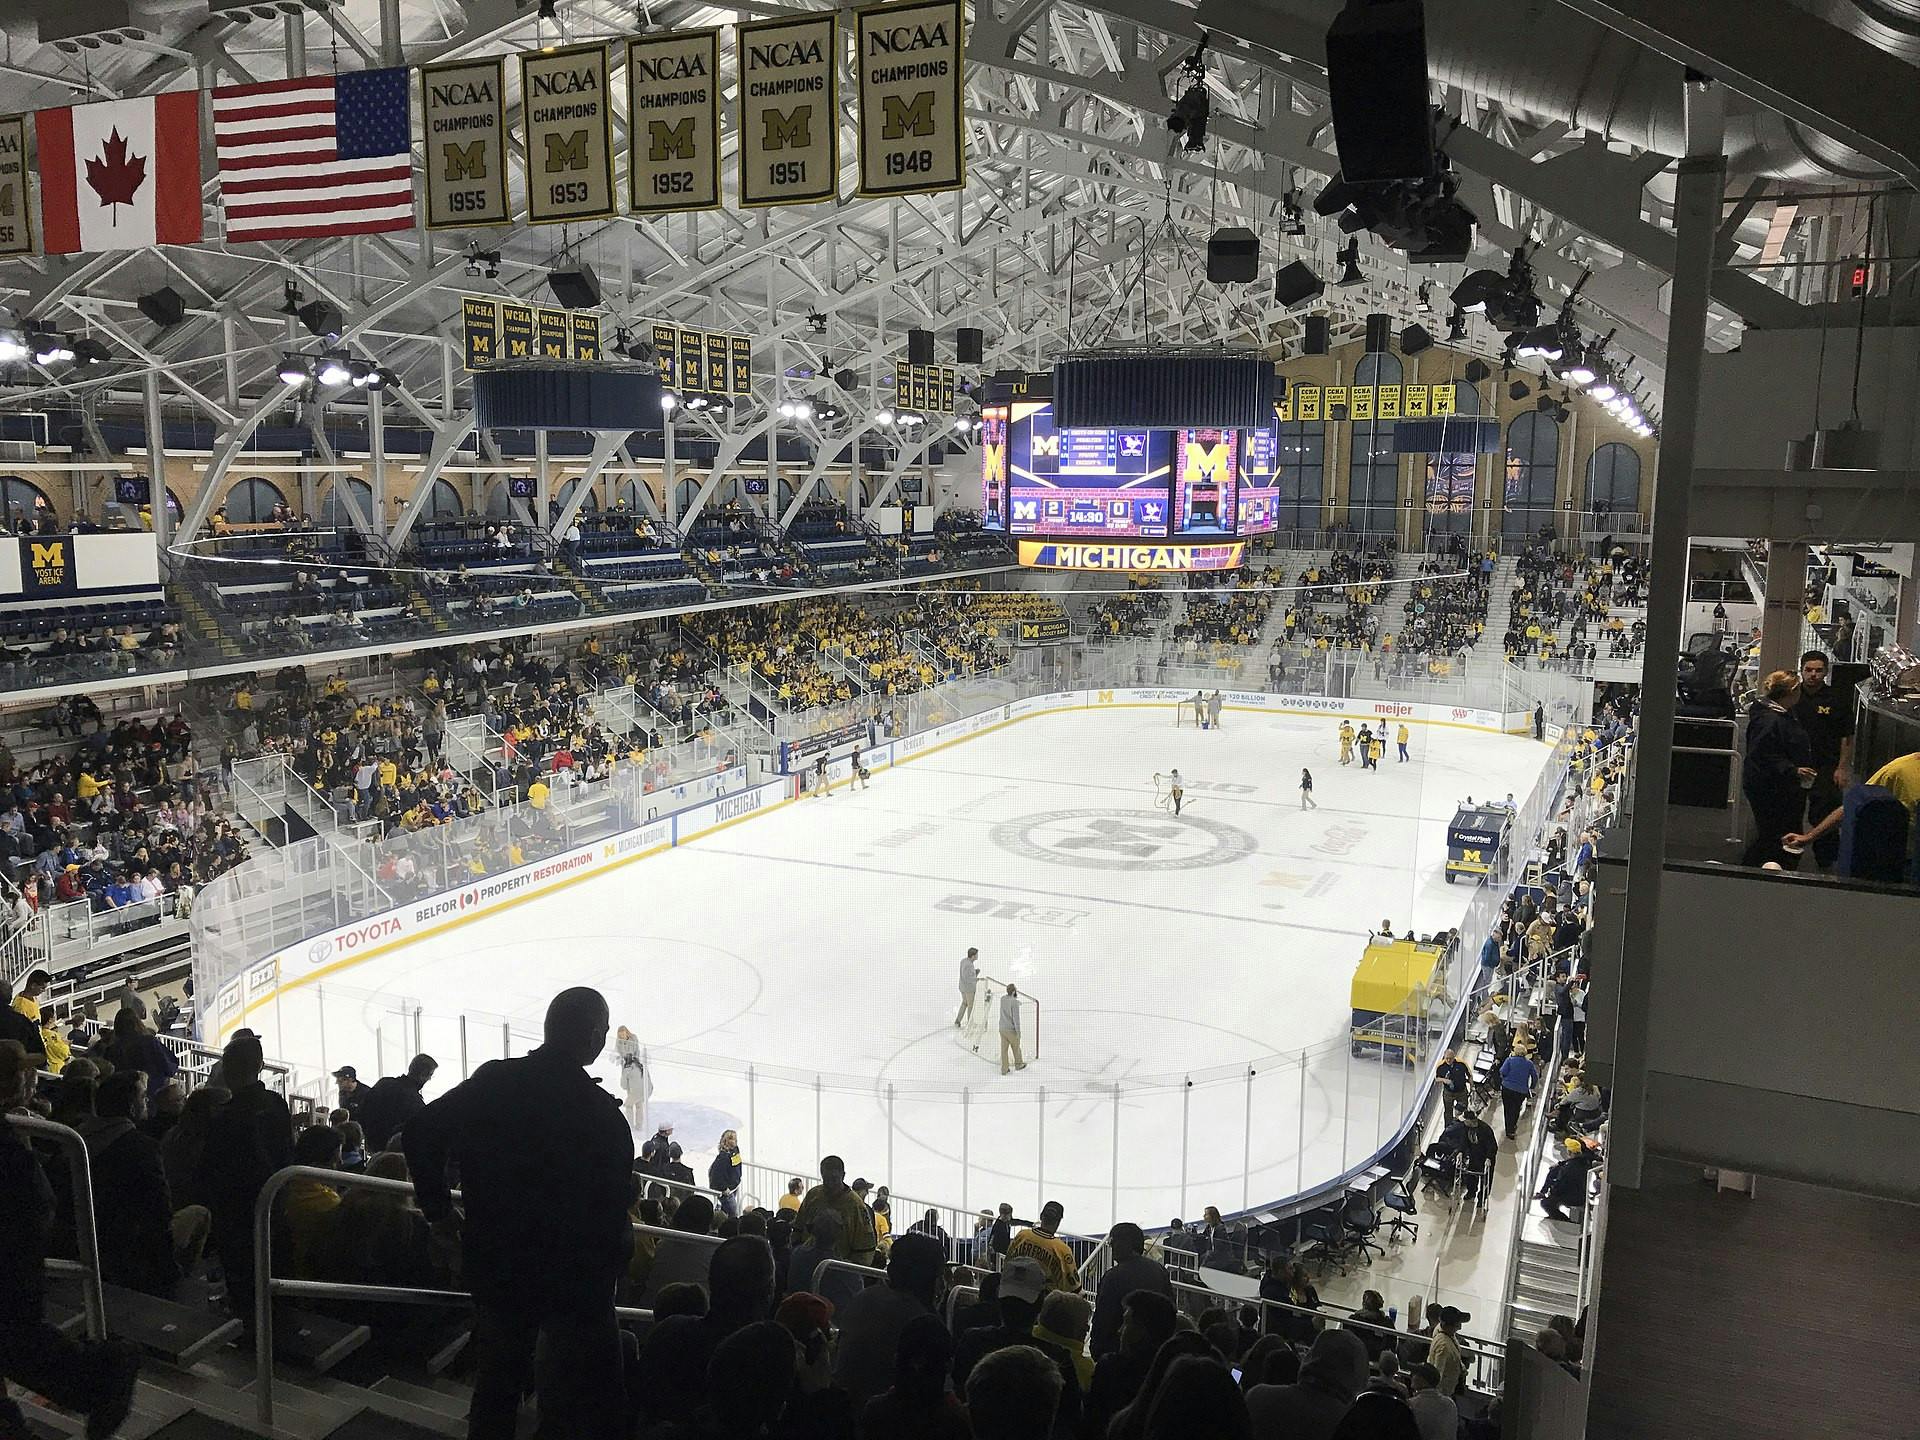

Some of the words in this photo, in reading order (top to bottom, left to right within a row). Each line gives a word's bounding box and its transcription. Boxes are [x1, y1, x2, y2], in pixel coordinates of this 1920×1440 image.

[868, 22, 949, 56] NCAA
[749, 39, 824, 70] NCAA
[637, 53, 707, 83] NCAA
[871, 60, 948, 84] CHAMPIONS
[532, 68, 597, 97] NCAA
[751, 76, 823, 97] CHAMPIONS
[431, 81, 493, 108] NCAA
[640, 89, 706, 109] CHAMPIONS
[534, 103, 597, 123] CHAMPIONS
[882, 91, 935, 140] M
[433, 114, 493, 132] CHAMPIONS
[762, 105, 812, 150] M
[0, 135, 18, 153] AA
[649, 117, 695, 161] M
[545, 130, 588, 173] M
[443, 140, 486, 181] M
[885, 150, 932, 175] 1948
[769, 161, 806, 185] 1951
[652, 172, 694, 194] 1952
[449, 190, 486, 212] 1955
[550, 182, 588, 205] 1953
[0, 226, 14, 242] 56
[466, 304, 493, 317] WCHA
[504, 309, 531, 323] WCHA
[540, 314, 565, 327] WCHA
[575, 318, 596, 331] CCHA
[472, 335, 489, 352] M
[655, 329, 673, 341] CCHA
[683, 334, 700, 345] CCHA
[709, 338, 725, 349] CCHA
[511, 340, 527, 356] M
[546, 343, 561, 359] M
[580, 346, 594, 361] M
[733, 341, 749, 350] CCHA
[659, 356, 672, 371] M
[686, 360, 697, 374] M
[712, 363, 723, 377] M
[737, 365, 747, 379] M
[1304, 404, 1314, 412] M
[1356, 403, 1368, 411] M
[1383, 402, 1395, 410] M
[1410, 402, 1422, 410] M
[1437, 402, 1448, 410] M
[1032, 435, 1059, 456] M
[985, 444, 1003, 481] M
[1184, 443, 1230, 482] M
[1013, 501, 1037, 520] M
[1048, 501, 1059, 515] 2
[1113, 502, 1124, 516] 0
[31, 543, 65, 568] M
[1056, 546, 1192, 569] MICHIGAN
[35, 569, 52, 578] YOST
[53, 568, 64, 576] ICE
[39, 576, 62, 585] ARENA
[1023, 624, 1039, 638] M
[1098, 690, 1114, 703] M
[1374, 702, 1414, 717] meijer
[1817, 705, 1831, 714] M
[715, 790, 762, 823] MICHIGAN
[603, 843, 615, 858] M
[618, 834, 642, 853] MICHIGAN
[1459, 834, 1477, 842] Crystal
[1463, 849, 1481, 863] M
[416, 899, 457, 923] BELFOR
[481, 873, 532, 900] PROPERTY
[533, 852, 593, 882] RESTORATION
[335, 917, 402, 952] TOYOTA
